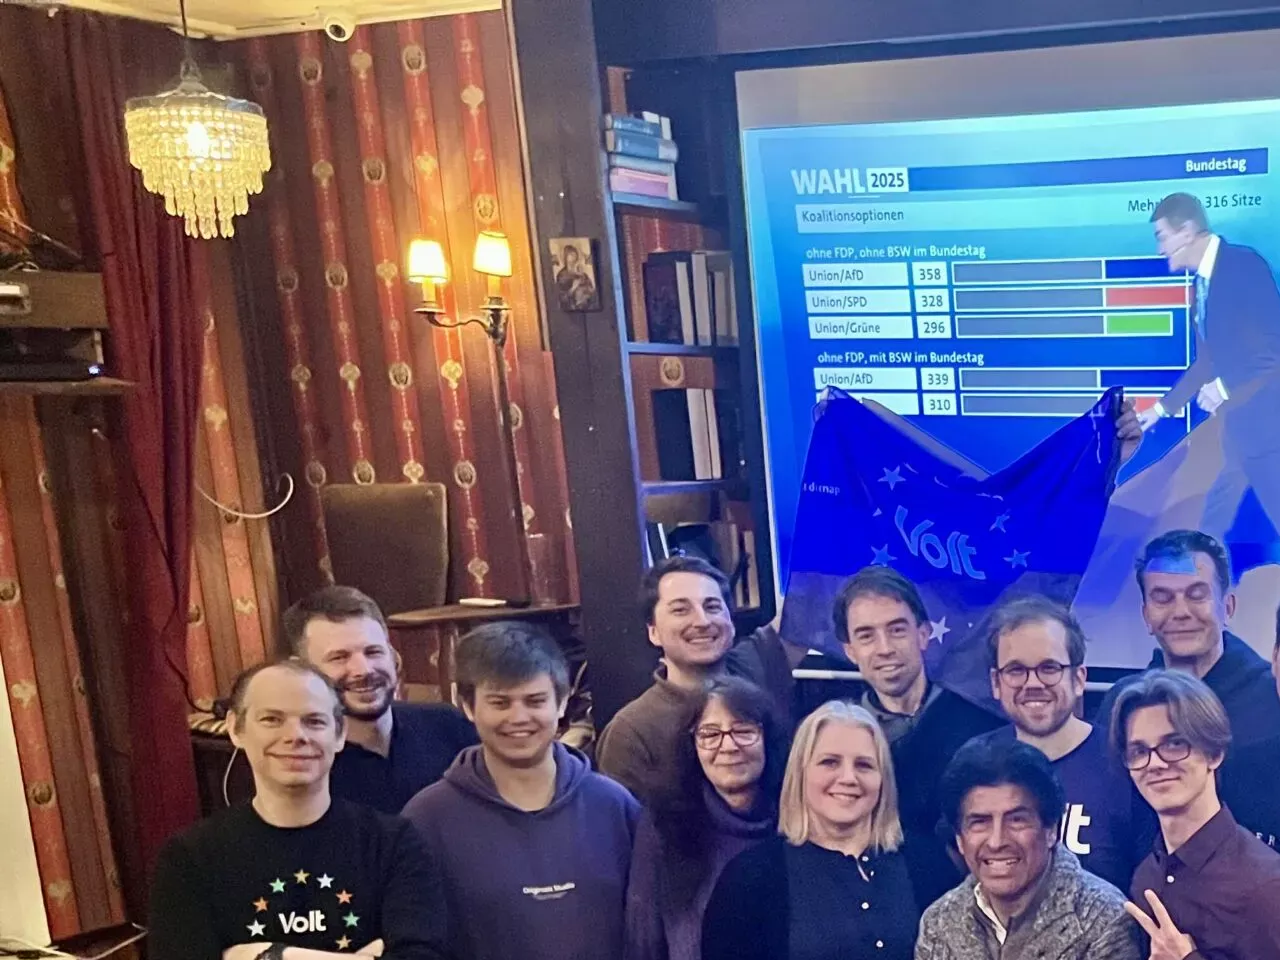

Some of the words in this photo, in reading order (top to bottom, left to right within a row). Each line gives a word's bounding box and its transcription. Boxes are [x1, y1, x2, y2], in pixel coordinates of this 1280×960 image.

[1186, 158, 1247, 172] Bundestag
[790, 168, 866, 195] WAHL
[870, 172, 905, 189] 2025
[1205, 195, 1228, 208] 316
[1231, 193, 1262, 207] Sitze
[802, 210, 905, 224] Koalitionsoptionen
[806, 247, 832, 259] ohne
[834, 247, 858, 261] FDP,
[860, 246, 885, 258] ohne
[887, 246, 911, 257] BSW
[914, 245, 927, 256] im
[929, 244, 986, 259] Bundestag
[809, 269, 864, 284] Union/AfD
[919, 268, 942, 281] 358
[812, 296, 867, 310] Union/SPD
[921, 295, 944, 308] 328
[814, 321, 881, 336] Union/Grüne
[923, 321, 946, 334] 296
[817, 352, 844, 364] ohne
[845, 352, 868, 365] FDP,
[869, 351, 887, 363] mit
[889, 351, 912, 363] BSW
[914, 351, 928, 363] im
[930, 351, 985, 366] Bundestag
[820, 373, 873, 386] Union/AfD
[927, 373, 949, 386] 339
[929, 399, 951, 411] 310
[894, 505, 987, 581] Volt
[278, 909, 327, 935] Volt
